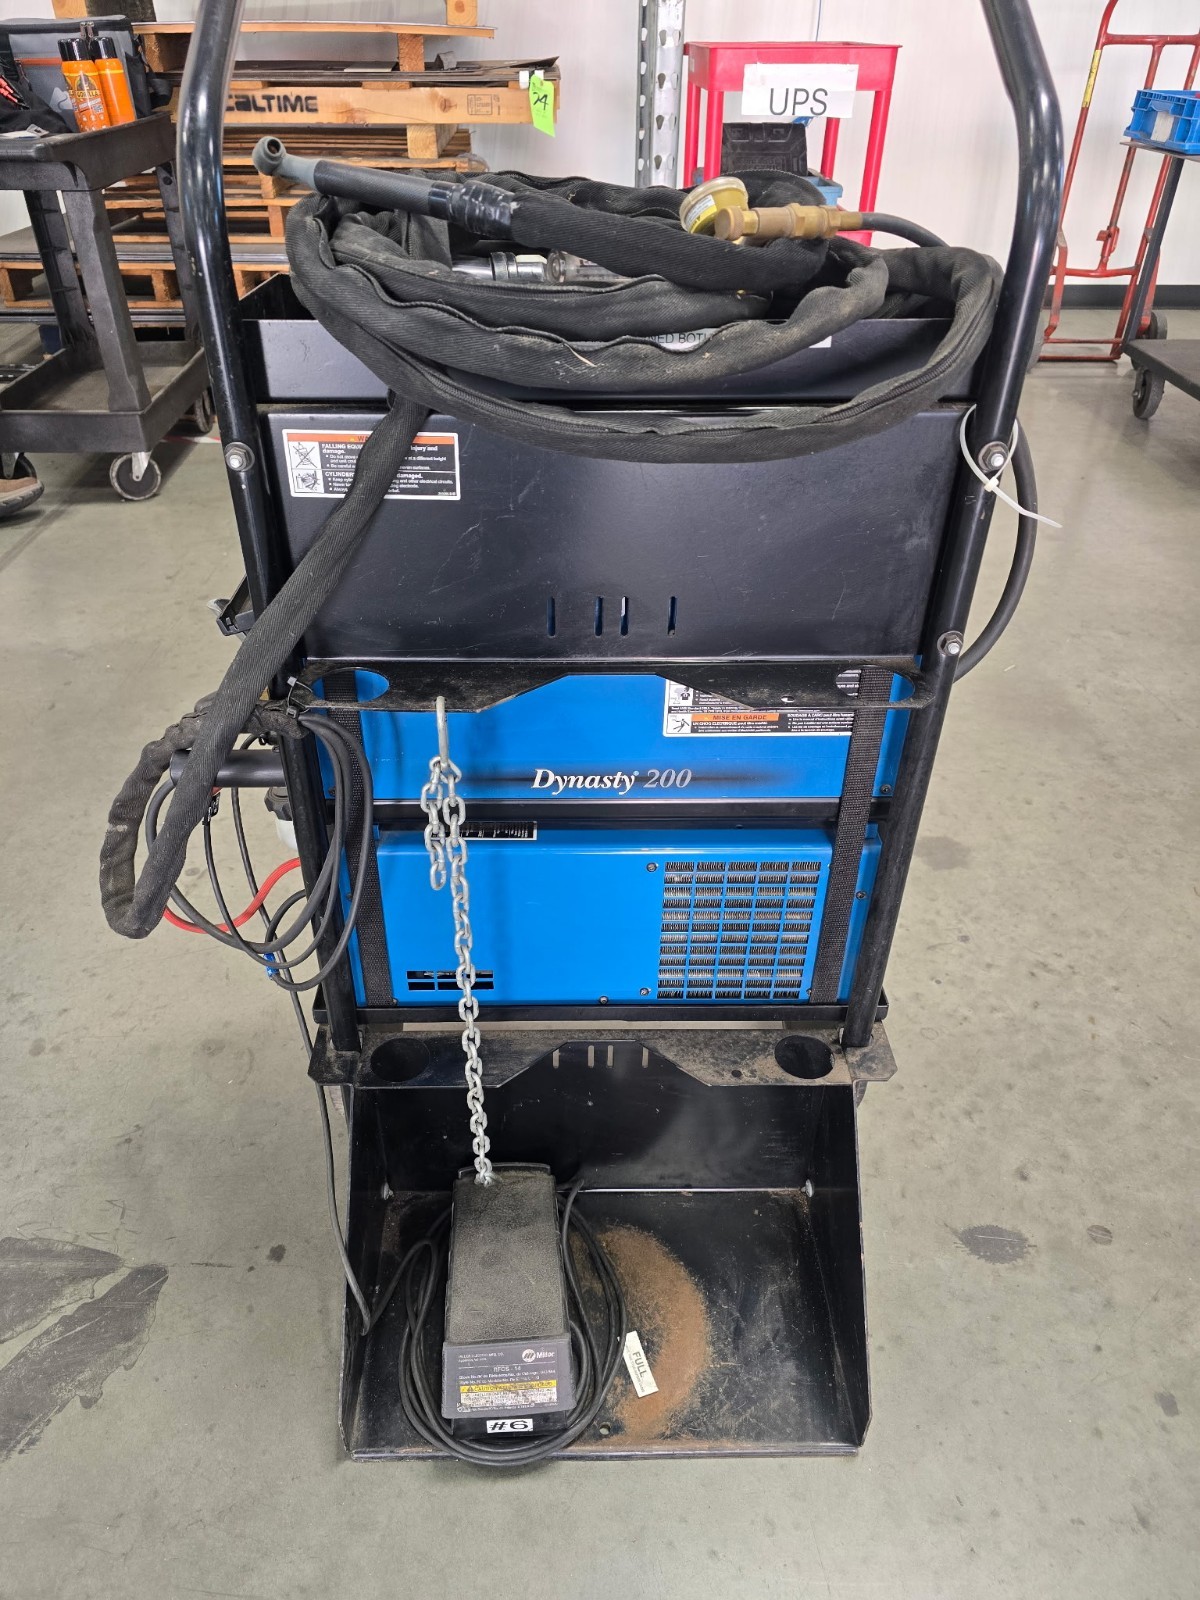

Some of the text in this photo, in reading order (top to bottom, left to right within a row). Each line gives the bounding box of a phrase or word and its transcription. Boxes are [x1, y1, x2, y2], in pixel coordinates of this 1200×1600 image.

[532, 92, 549, 110] 24
[769, 88, 828, 116] UPS
[530, 768, 692, 796] Dynasty 200
[632, 1351, 647, 1378] FULL
[489, 1419, 529, 1431] #6
